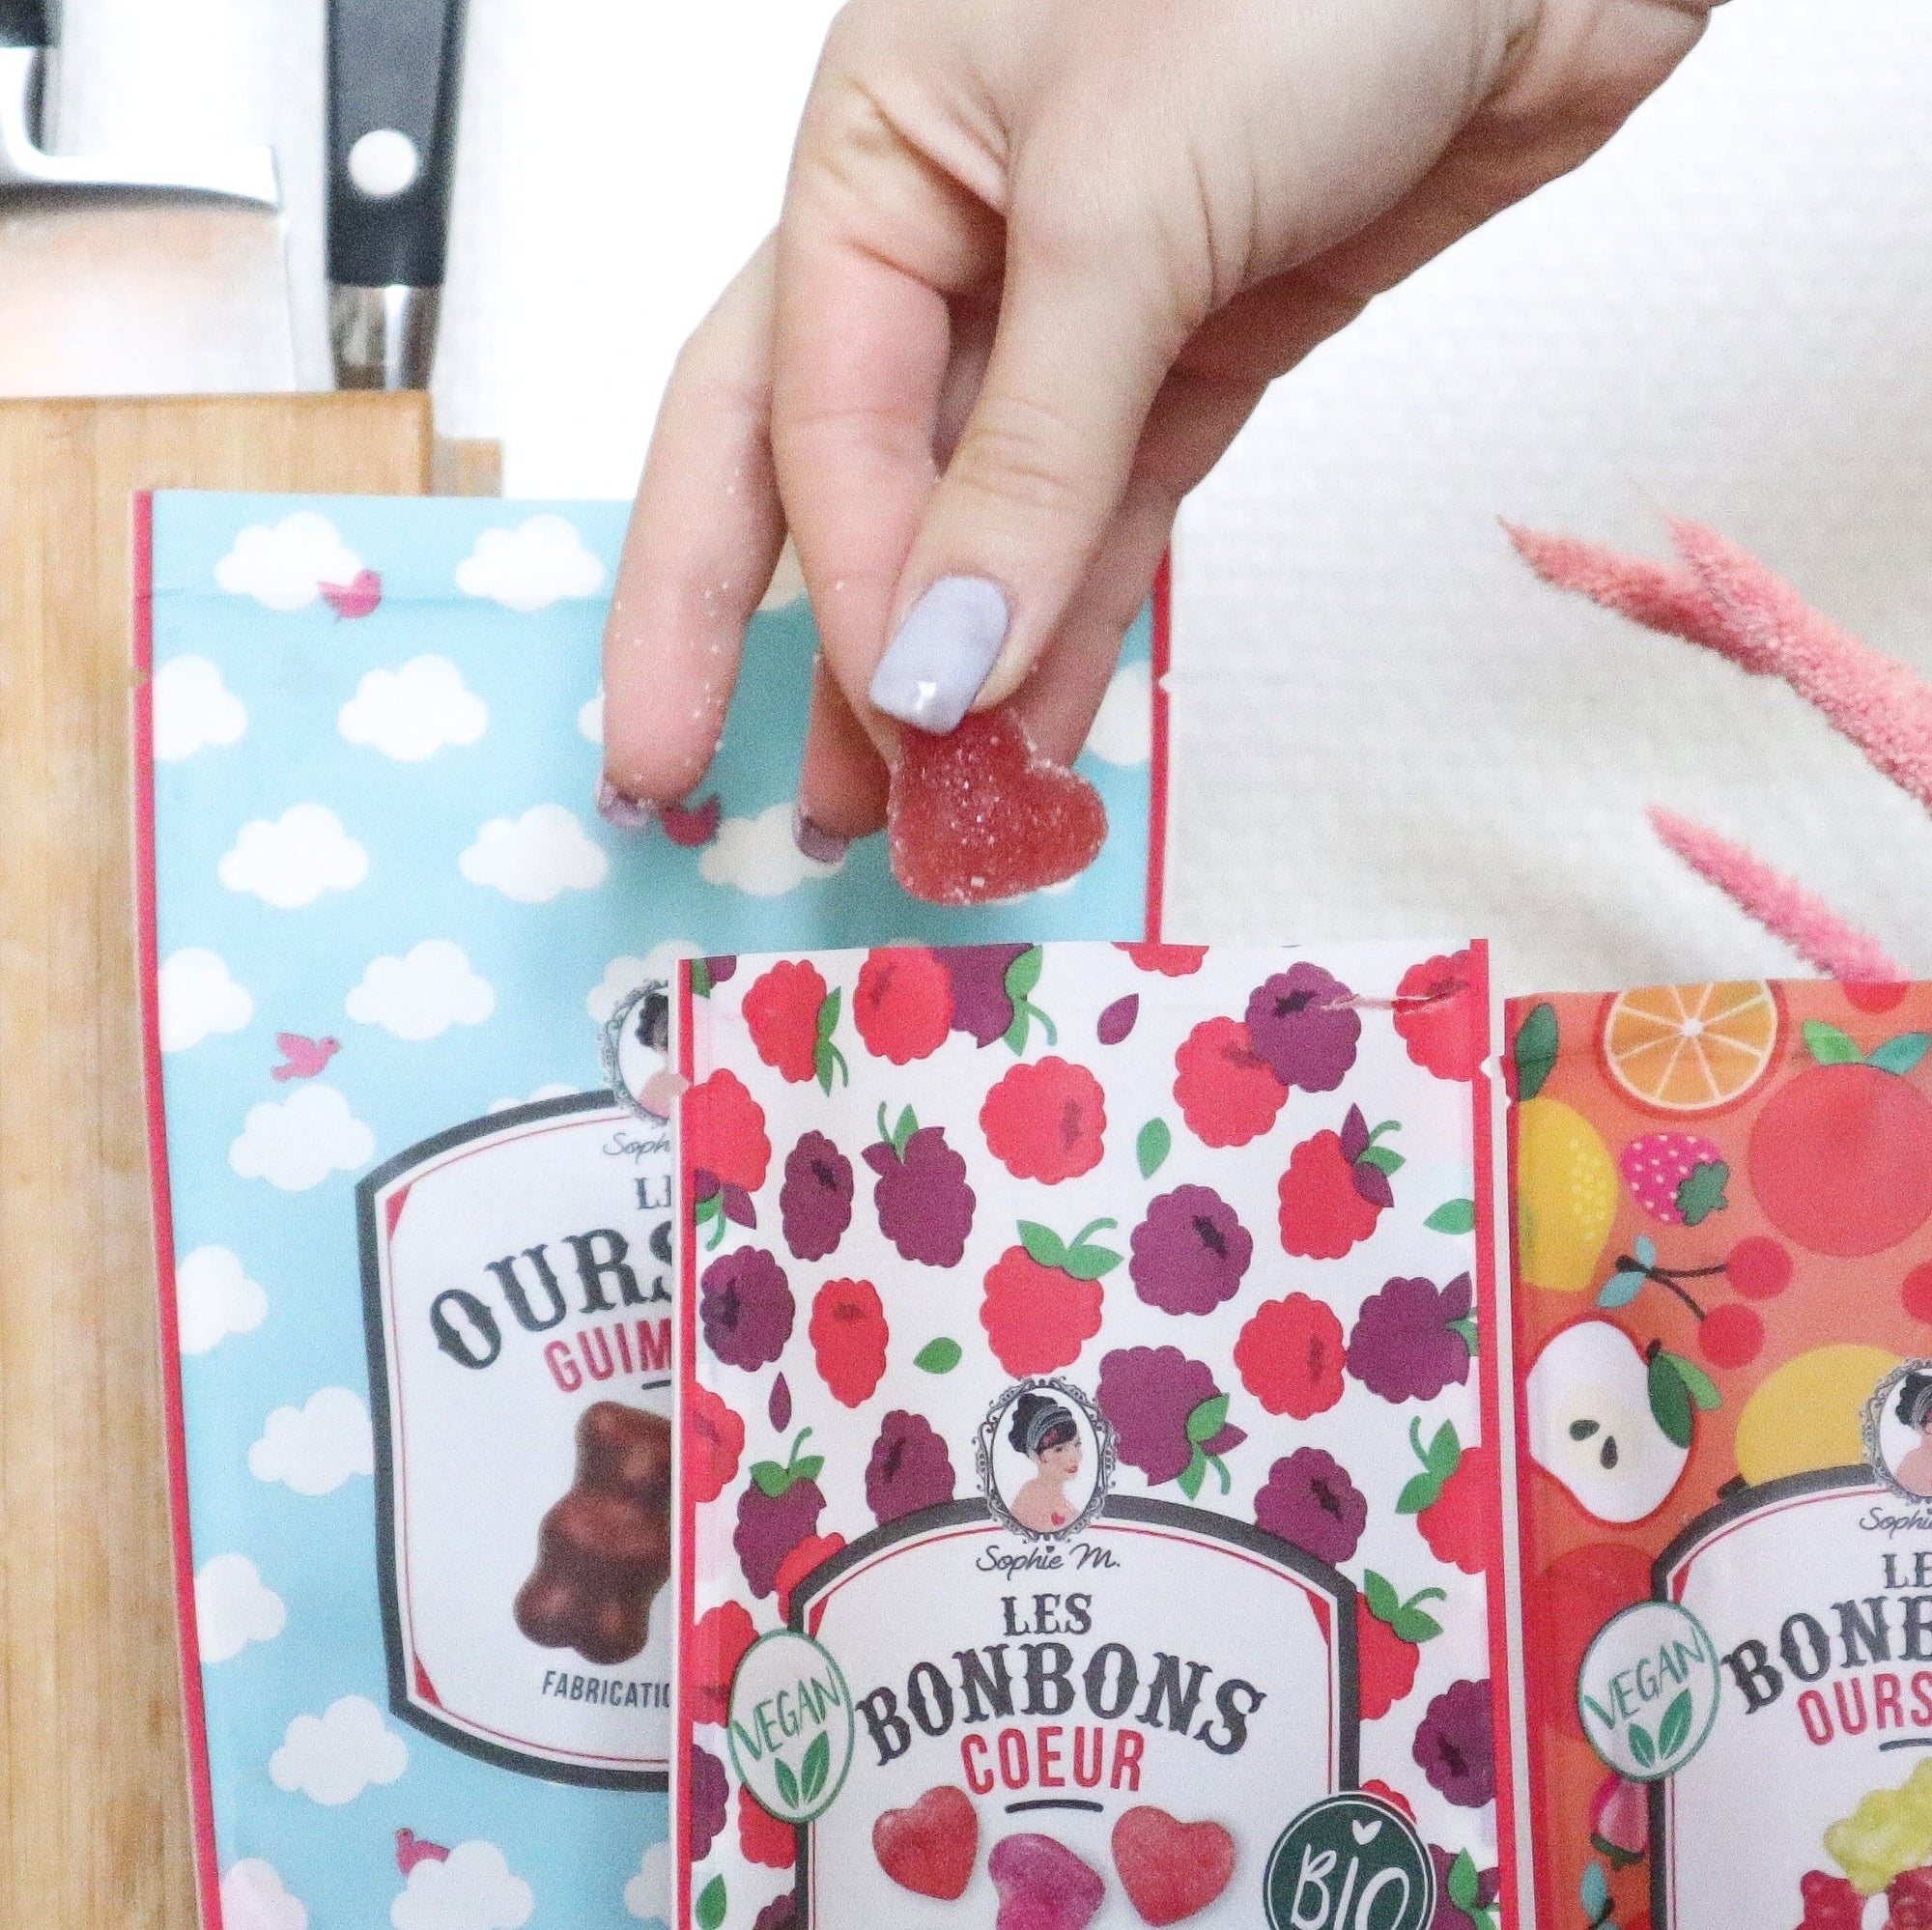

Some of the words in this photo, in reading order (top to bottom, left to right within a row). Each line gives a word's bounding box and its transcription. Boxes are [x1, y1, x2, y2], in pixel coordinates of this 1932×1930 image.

[976, 1545, 1065, 1581] Sophie
[1068, 1543, 1121, 1571] M.
[1001, 1593, 1093, 1636] LES
[731, 1665, 840, 1762] VEGAN
[855, 1642, 1267, 1768] BONBONS
[1584, 1627, 1705, 1730] VEGAN
[1798, 1670, 1932, 1746] OURS
[960, 1724, 1145, 1796] COEUR
[1291, 1842, 1410, 1930] BIO
